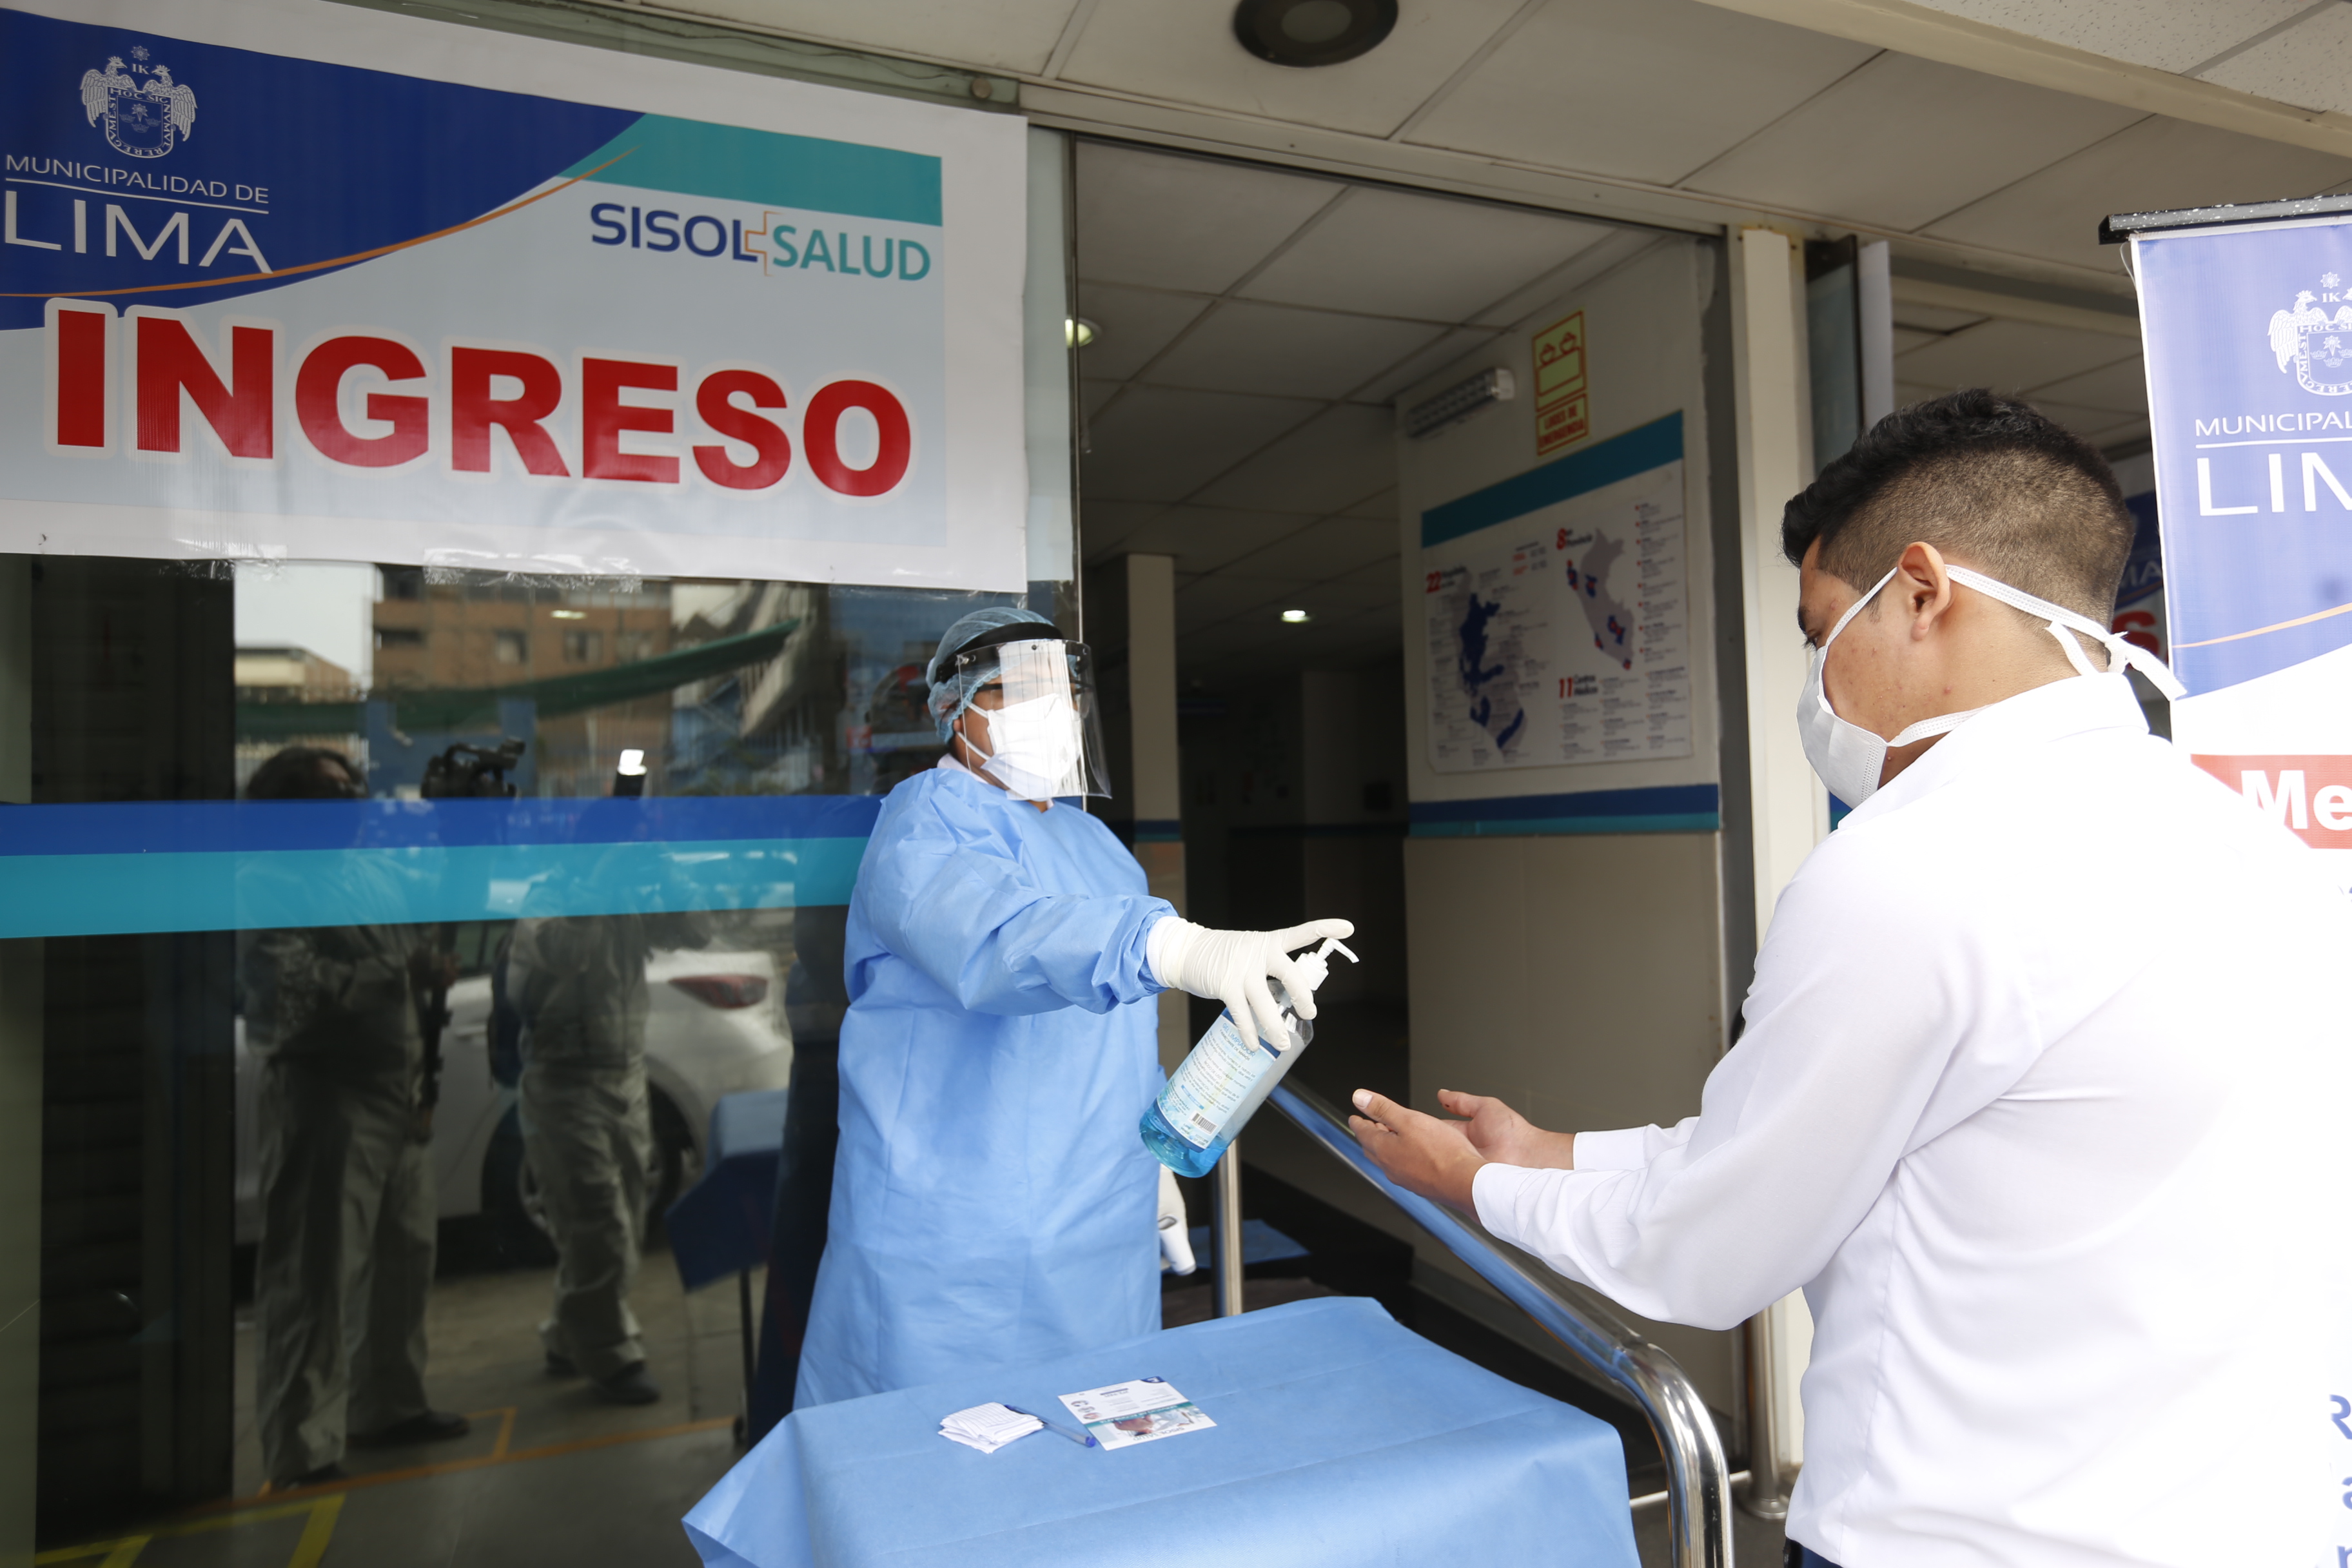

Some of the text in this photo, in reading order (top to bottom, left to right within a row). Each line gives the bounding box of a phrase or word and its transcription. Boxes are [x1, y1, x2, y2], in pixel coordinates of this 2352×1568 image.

[6, 155, 270, 203] MUNICIPALIDAD DE
[5, 190, 273, 274] LIMA
[590, 202, 931, 281] SISOL SALUD
[58, 309, 912, 496] INGRESO
[1556, 528, 1566, 550] 8
[1426, 571, 1442, 594] 22
[1559, 676, 1573, 699] 11
